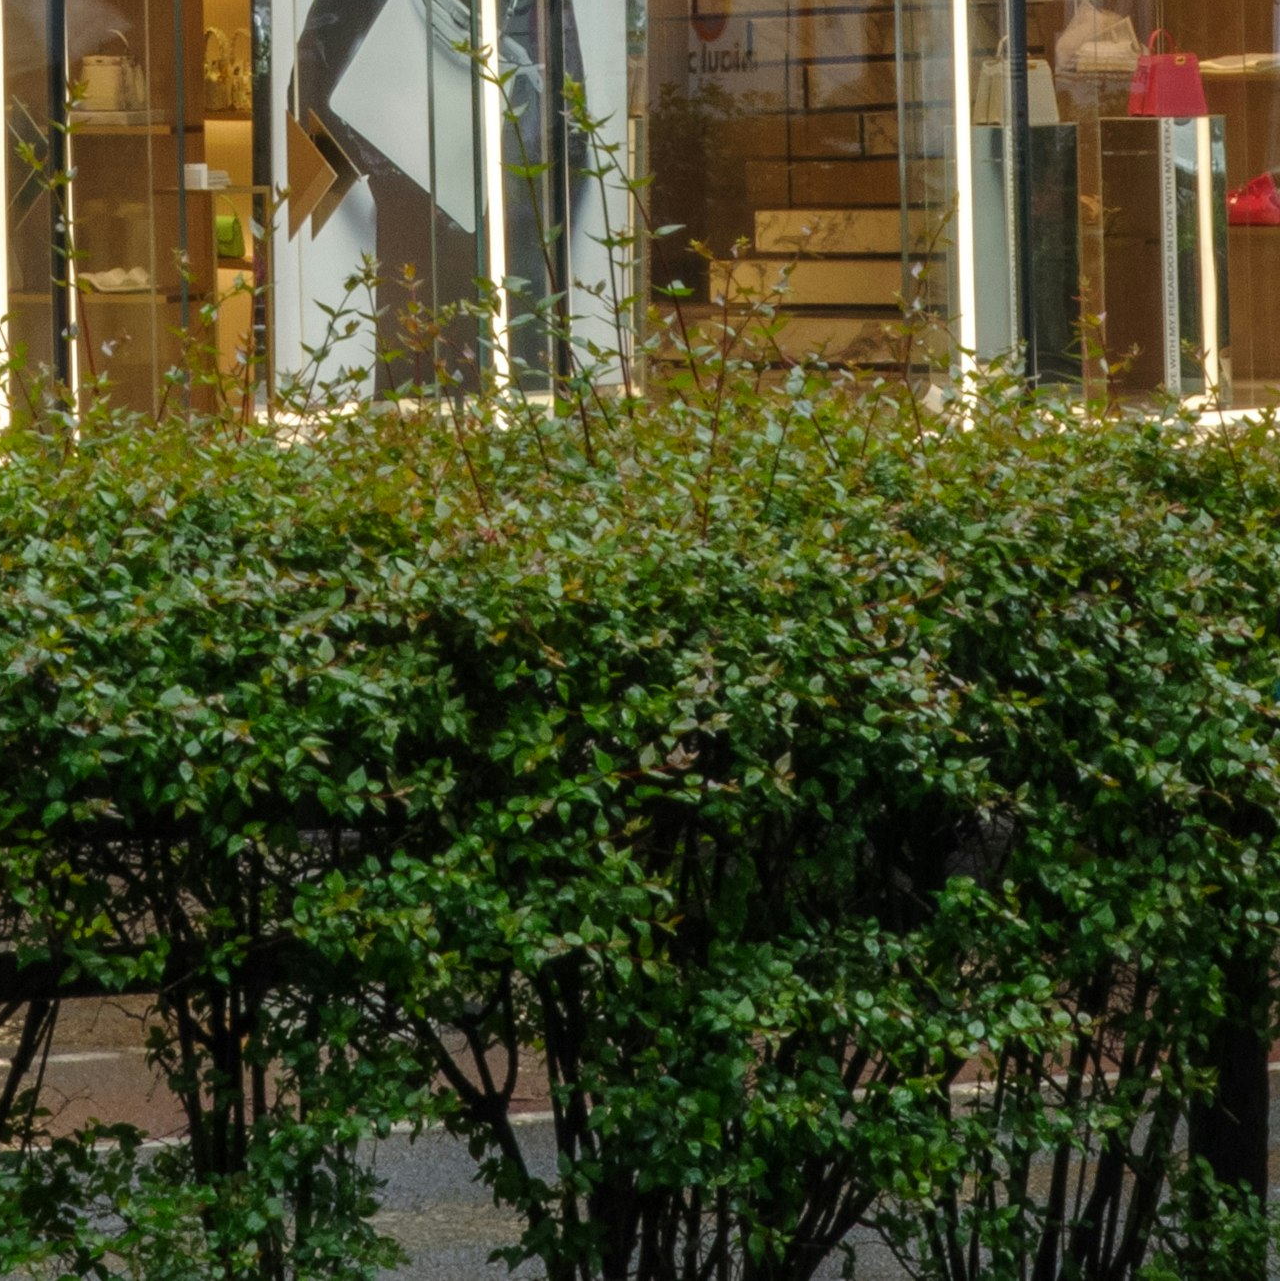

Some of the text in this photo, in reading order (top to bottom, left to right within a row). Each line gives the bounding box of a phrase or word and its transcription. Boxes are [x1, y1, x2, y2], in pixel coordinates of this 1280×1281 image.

[1165, 176, 1173, 206] WITH
[1166, 209, 1174, 237] LOVE
[1166, 255, 1176, 317] PEEKABOO
